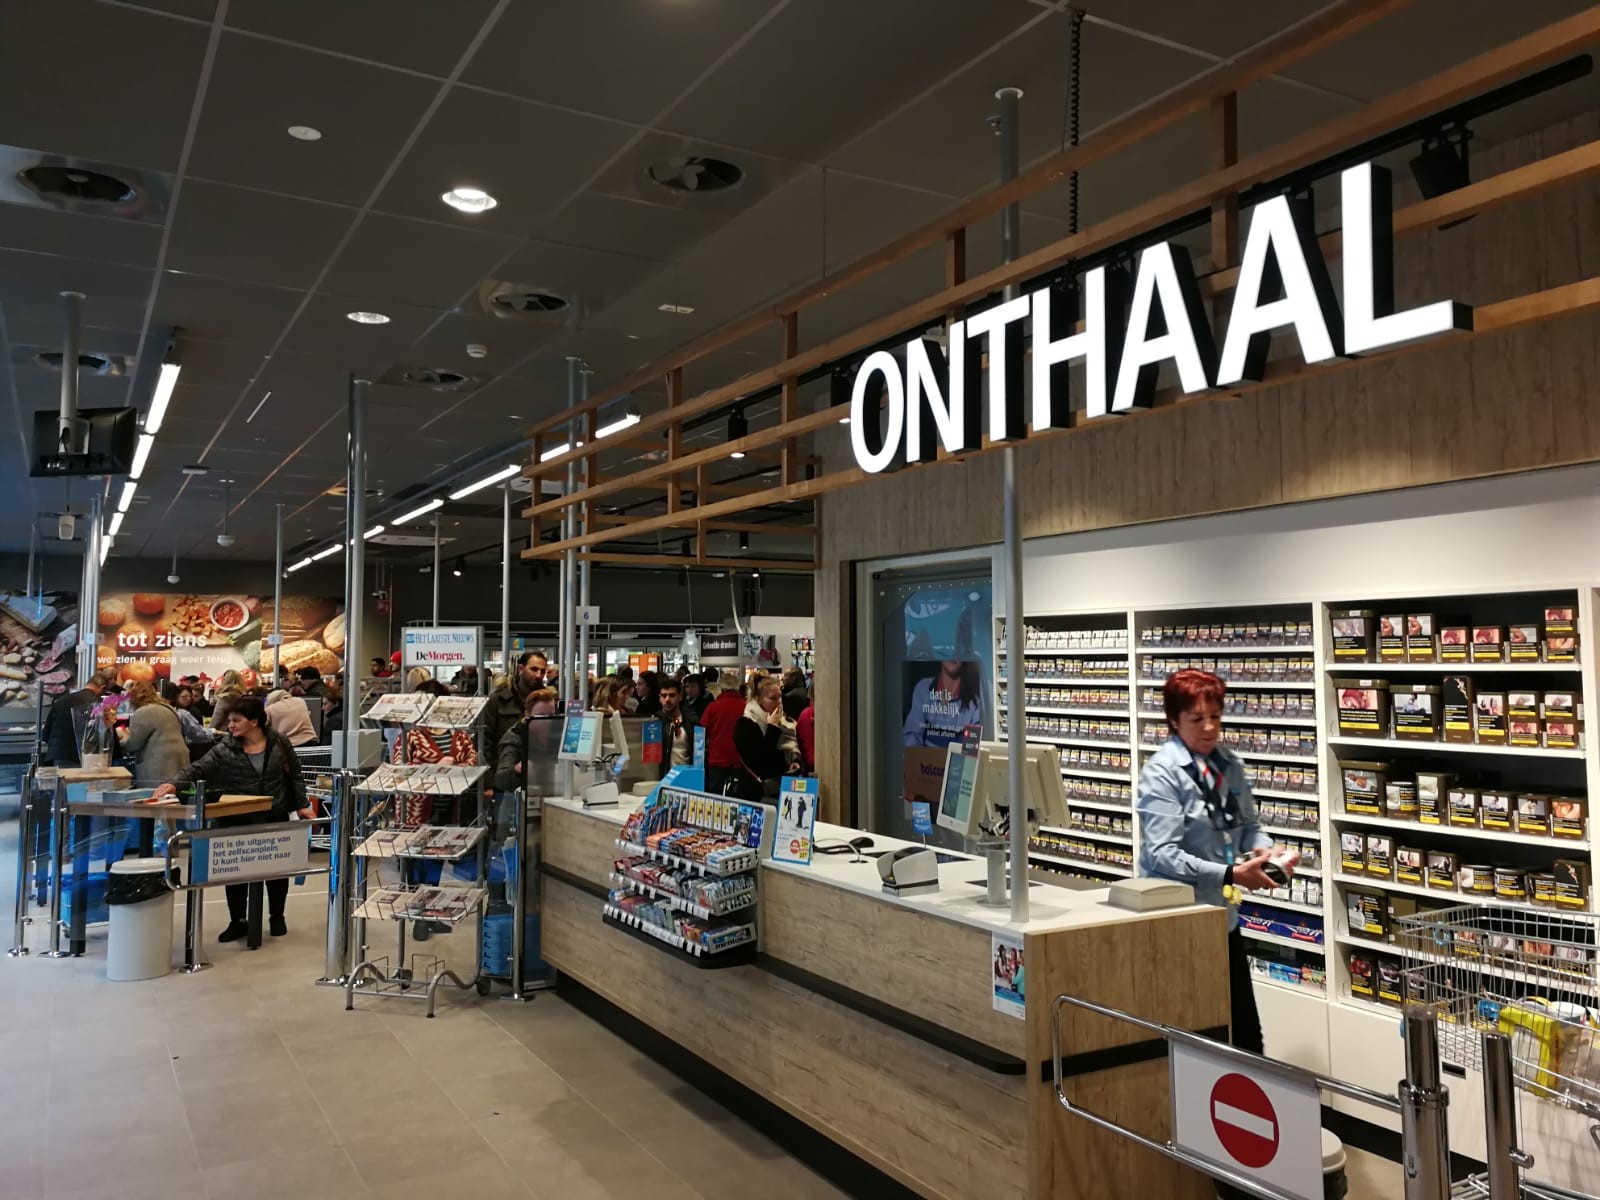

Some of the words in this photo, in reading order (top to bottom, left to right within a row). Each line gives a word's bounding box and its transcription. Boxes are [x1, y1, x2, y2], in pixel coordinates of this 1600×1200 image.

[850, 160, 1455, 475] ONTHAAL
[583, 611, 590, 620] 6
[118, 631, 148, 647] tot
[155, 631, 207, 647] ziens
[720, 640, 737, 649] dranken
[97, 656, 111, 664] we
[116, 655, 136, 664] zien
[140, 656, 146, 664] u
[150, 656, 177, 665] graag
[180, 656, 204, 664] weer
[207, 655, 232, 665] terug
[929, 688, 943, 700] dat
[944, 688, 952, 700] is
[922, 703, 960, 718] makkelijk
[213, 841, 224, 849] Dit
[236, 839, 245, 847] de
[247, 838, 275, 846] uitgang
[221, 856, 238, 865] kunt
[240, 855, 255, 863] hier
[258, 853, 272, 861] niet
[274, 852, 291, 860] naar
[212, 865, 240, 874] binnen.
